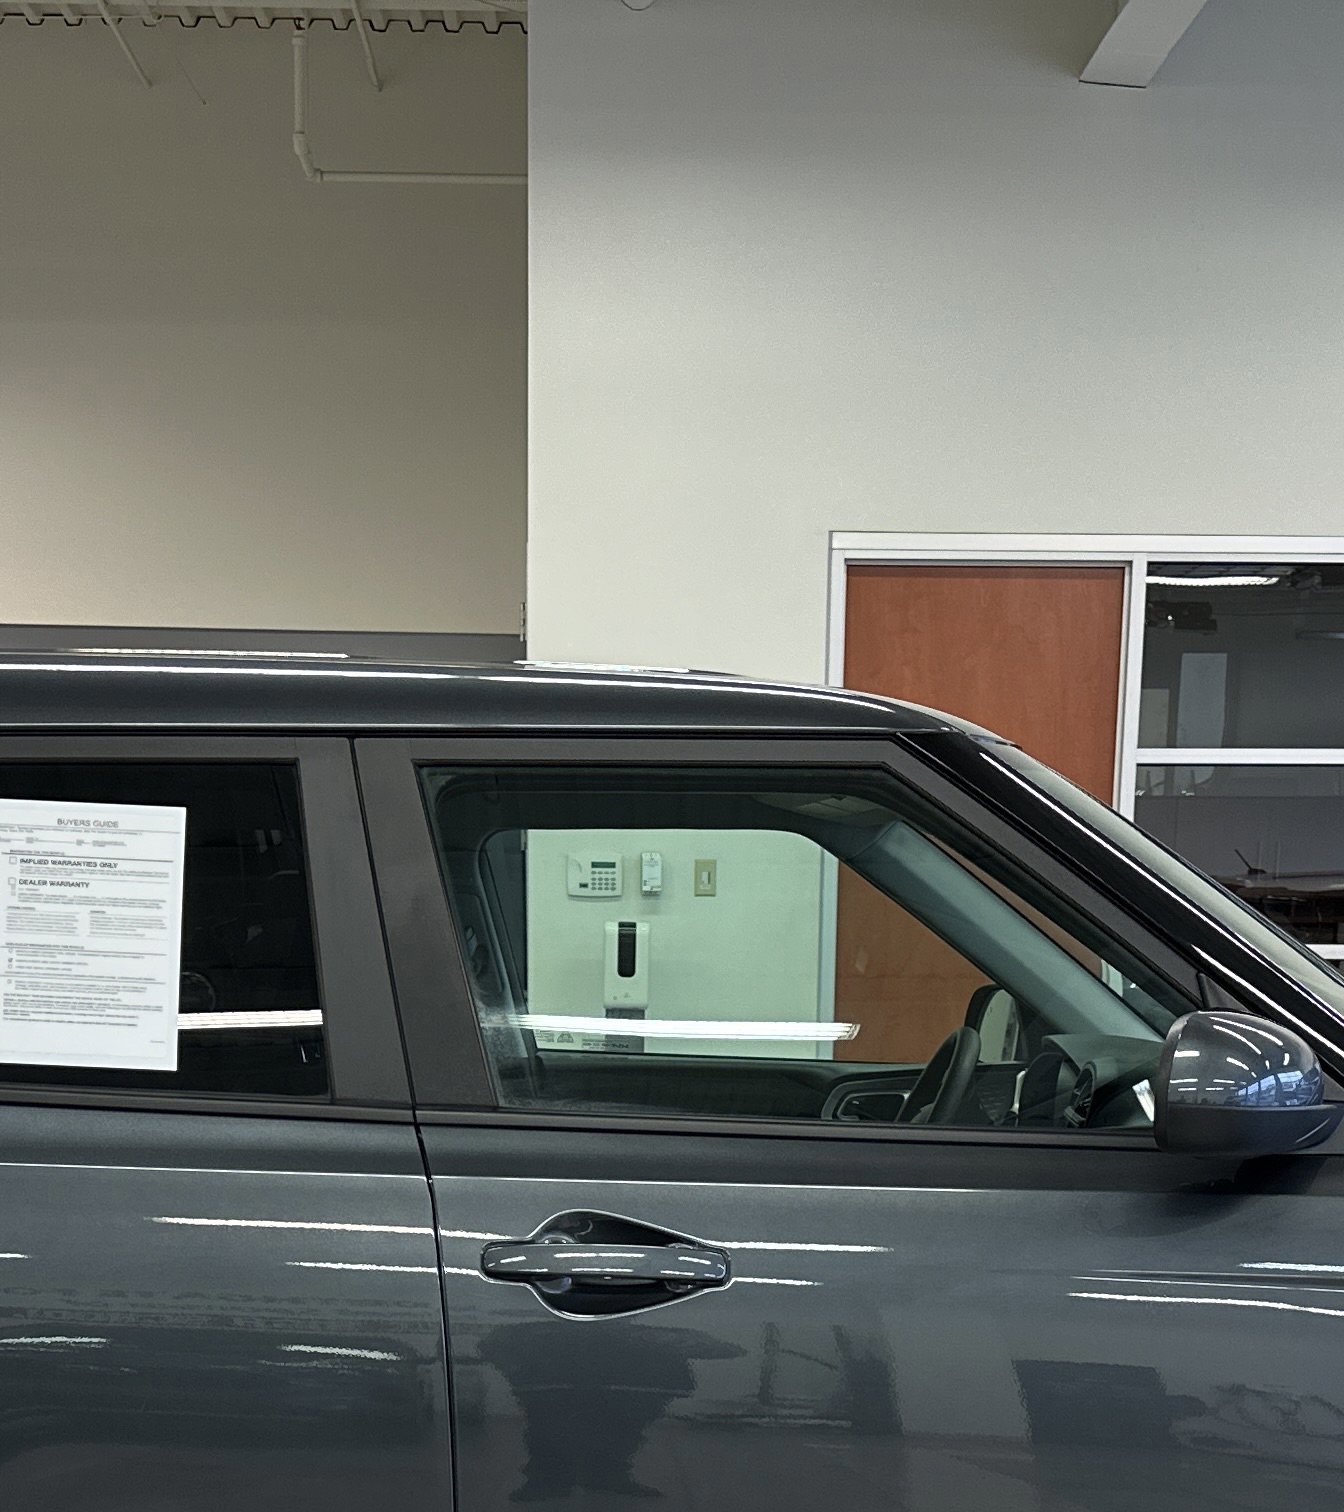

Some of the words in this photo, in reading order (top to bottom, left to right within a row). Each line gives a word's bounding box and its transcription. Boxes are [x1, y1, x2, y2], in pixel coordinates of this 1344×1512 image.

[56, 818, 91, 828] BUYERS
[92, 819, 119, 829] GUIDE
[19, 857, 49, 866] IMPLIED
[50, 859, 98, 868] WARRANTIES
[99, 861, 119, 870] ONLY
[18, 878, 48, 887] DEALER
[49, 880, 90, 889] WARRANTY
